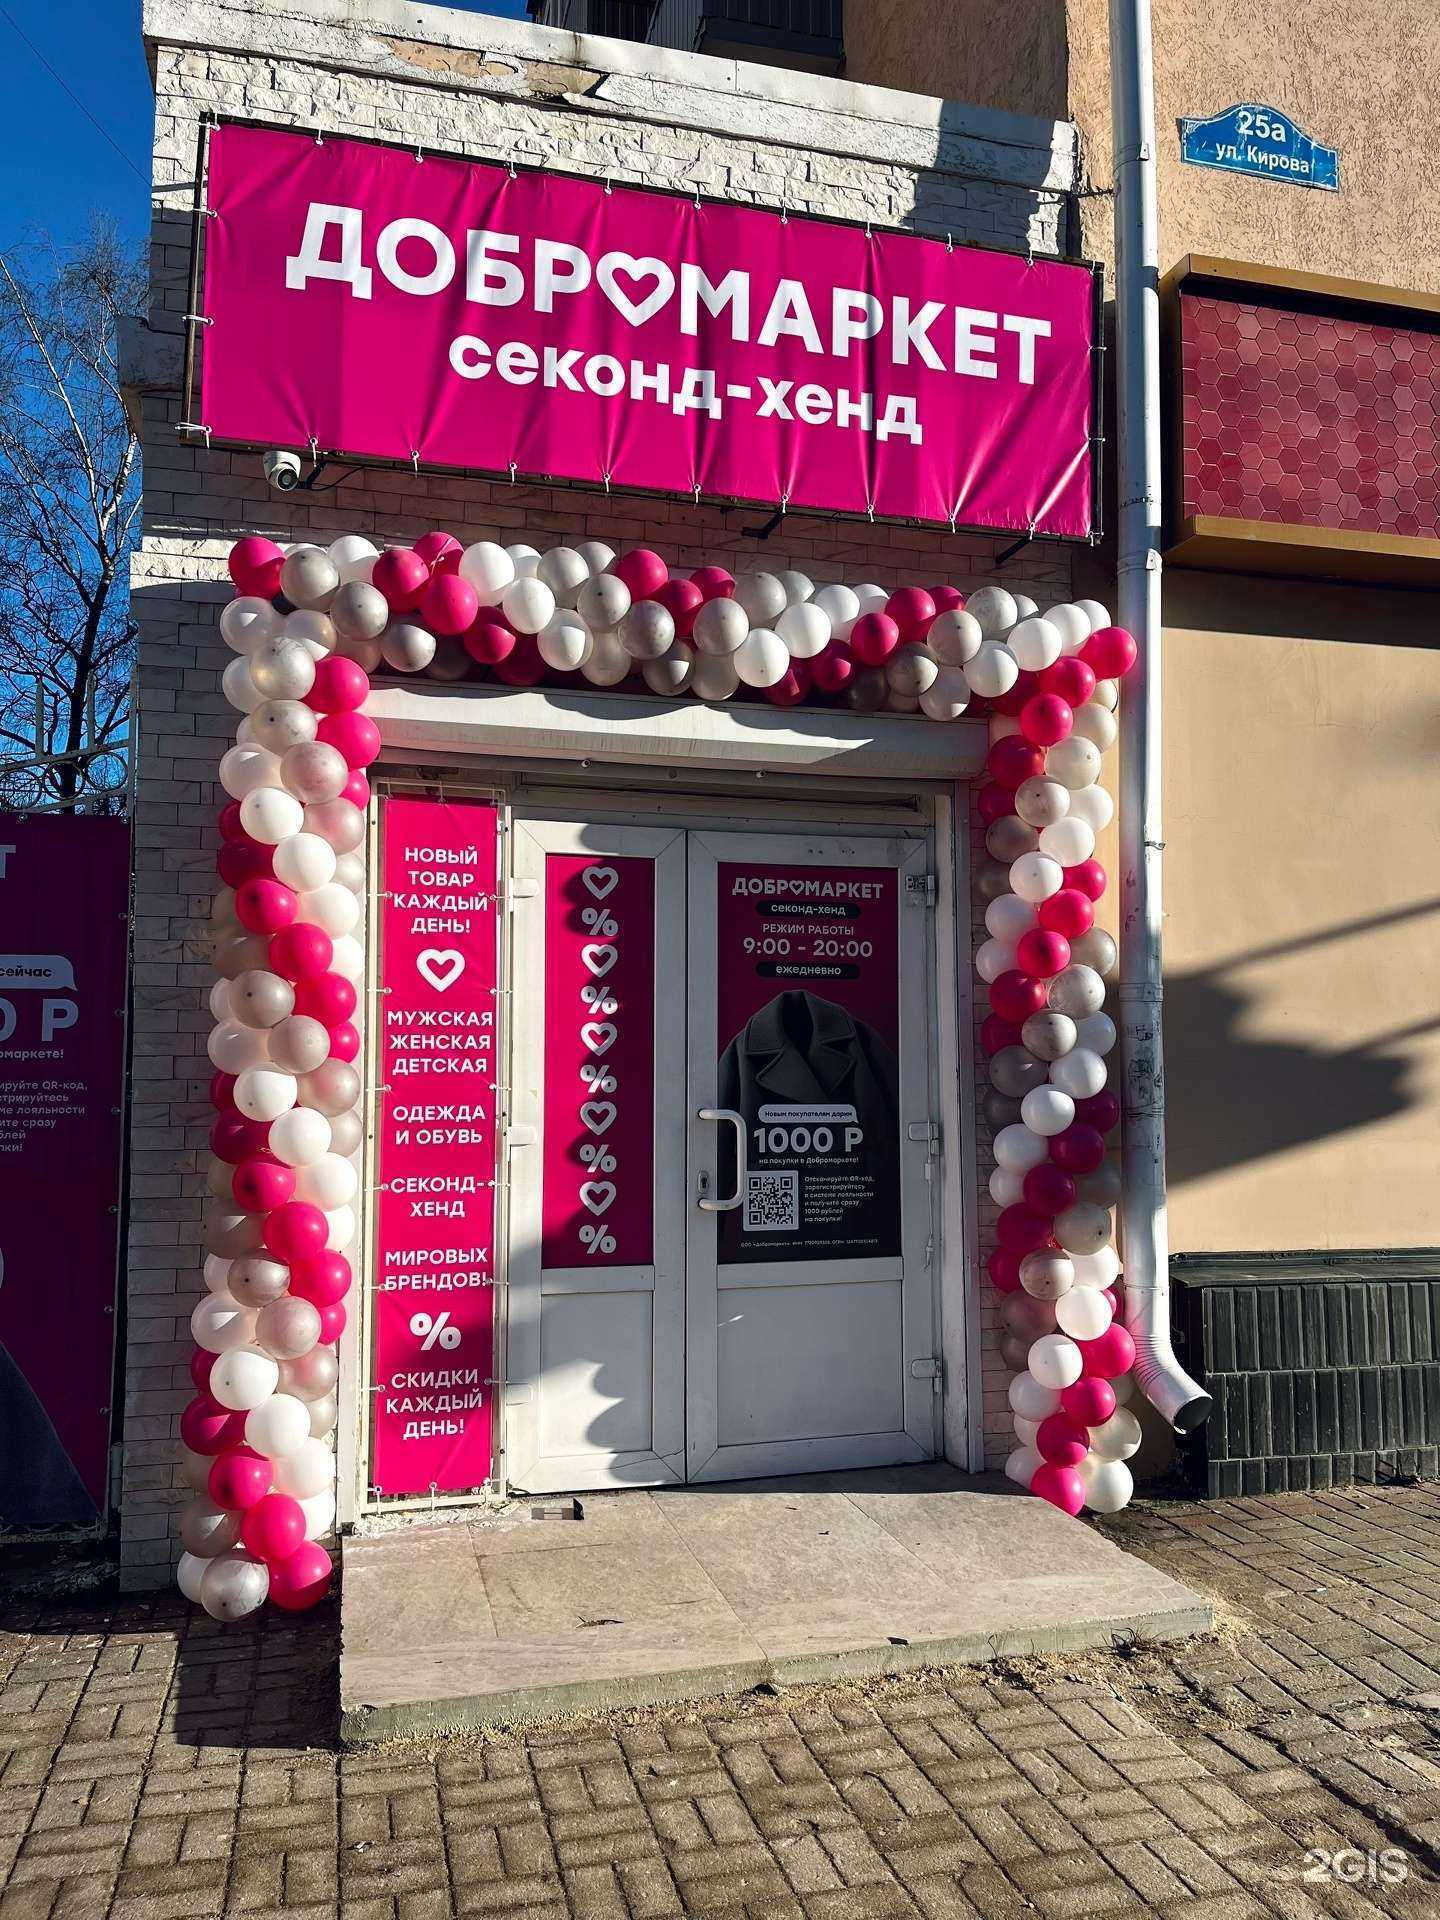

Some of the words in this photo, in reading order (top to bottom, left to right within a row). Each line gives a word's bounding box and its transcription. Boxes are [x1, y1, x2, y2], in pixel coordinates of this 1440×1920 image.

[1238, 110, 1286, 143] 25а
[1215, 142, 1242, 161] ул.
[1247, 144, 1310, 174] Кирова
[448, 335, 923, 445] секонд-хенд
[404, 845, 478, 865] НОВЫЙ
[407, 870, 475, 887] ТОВАР
[392, 891, 488, 912] КАЖДЫЙ
[770, 904, 847, 916] секонд-хенд
[410, 917, 471, 934] ДЕНЬ!
[762, 924, 805, 934] РЕЖИМ
[808, 925, 854, 936] РАБОТЫ
[743, 937, 791, 956] 9:00
[813, 939, 873, 958] 20:00
[775, 965, 843, 977] ежедневно
[387, 1010, 493, 1026] МУЖСКАЯ
[389, 1034, 491, 1050] ЖЕНСКАЯ
[392, 1058, 488, 1076] ДЕТСКАЯ
[42, 1080, 88, 1092] QR-код,
[0, 1093, 70, 1105] трируйтесь
[16, 1106, 86, 1115] лояльности
[392, 1105, 486, 1123] ОДЕЖДА
[22, 1119, 57, 1129] сразу
[396, 1129, 410, 1144] И
[416, 1129, 483, 1145] ОБУВЬ
[753, 1126, 834, 1154] 1000
[844, 1127, 864, 1153] Р
[390, 1176, 485, 1195] СЕКОНД-
[410, 1201, 466, 1219] ХЕНД
[385, 1247, 488, 1266] МИРОВЫХ
[385, 1271, 488, 1292] БРЕНДОВ!
[391, 1368, 479, 1390] СКИДКИ
[386, 1388, 483, 1414] КАЖДЫЙ
[402, 1419, 465, 1440] ДЕНЬ!
